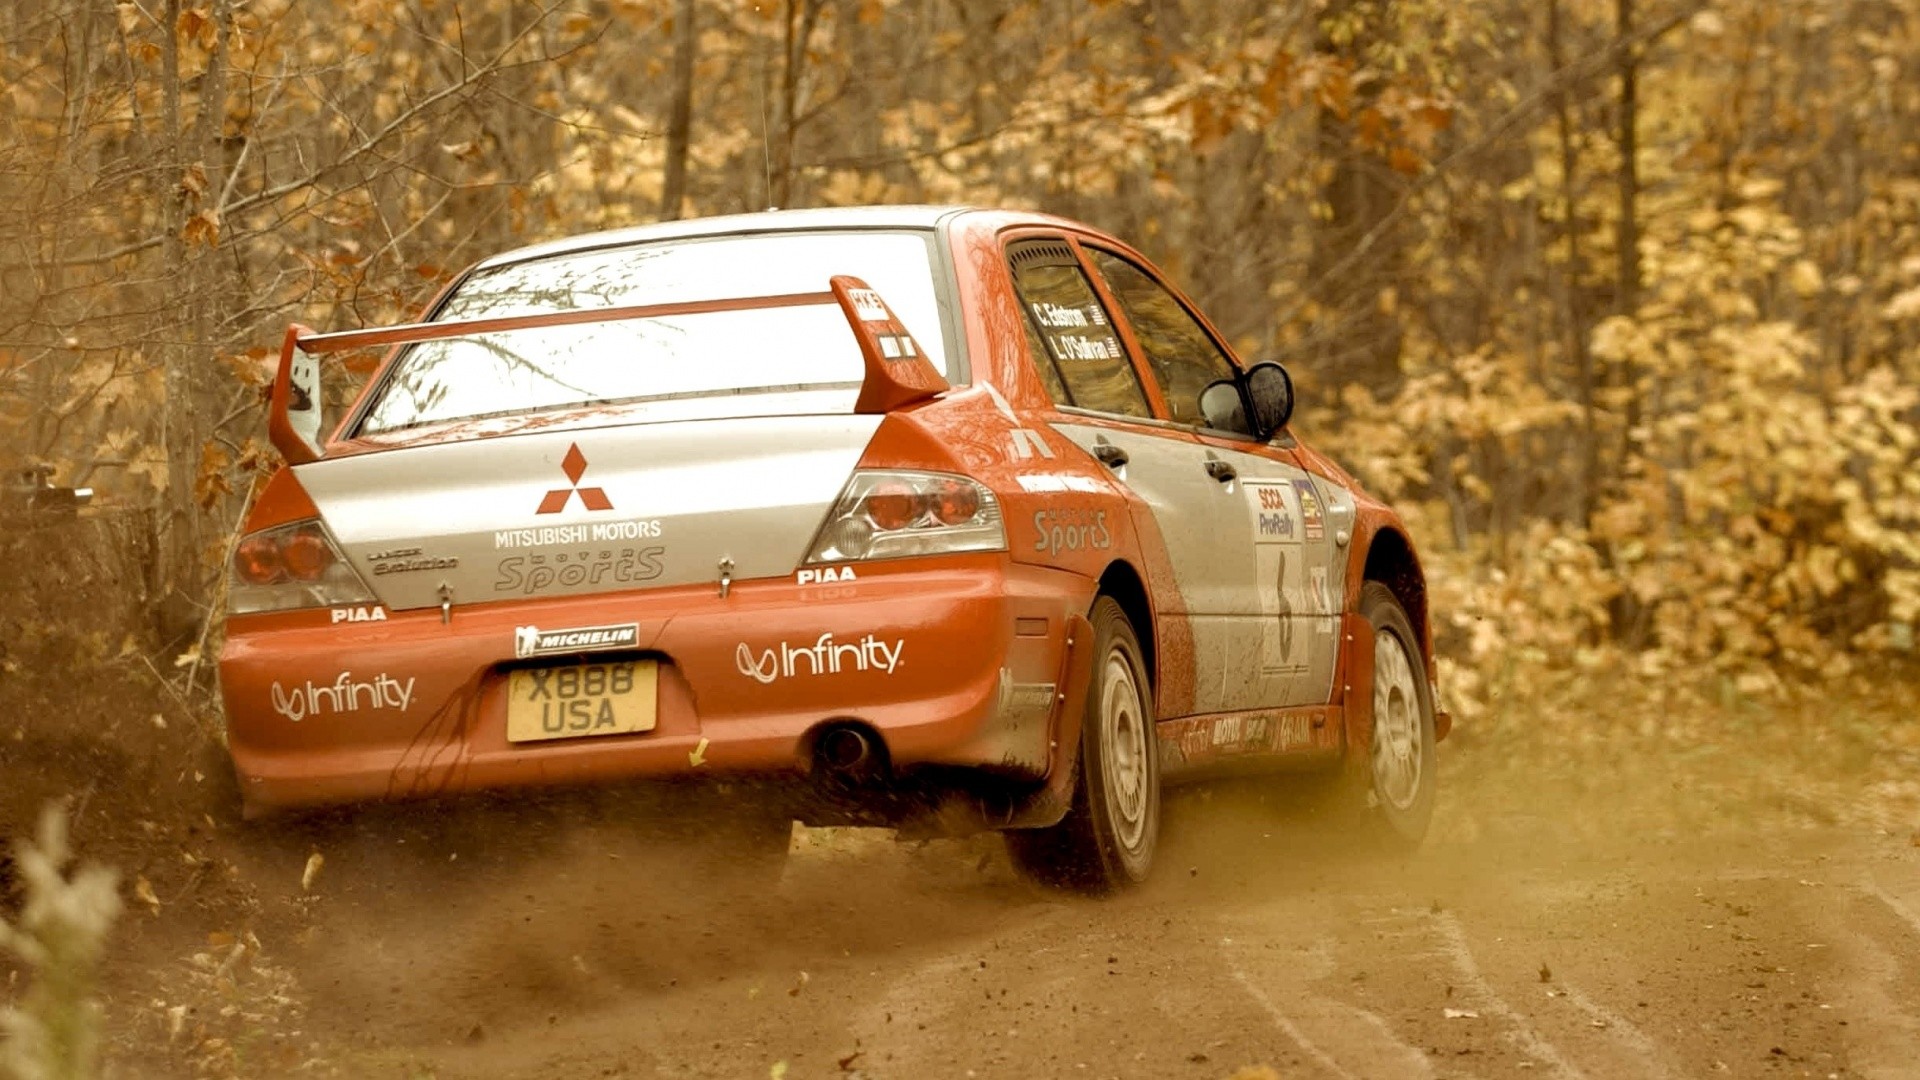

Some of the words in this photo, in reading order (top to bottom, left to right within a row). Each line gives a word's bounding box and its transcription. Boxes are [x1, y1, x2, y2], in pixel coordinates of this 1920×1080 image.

[1032, 303, 1051, 326] C.
[1049, 336, 1067, 359] L.
[1258, 488, 1287, 509] SCCA
[495, 525, 588, 548] MITSUBISHI
[592, 520, 661, 541] MOTORS
[1259, 513, 1294, 540] ProRally
[797, 566, 857, 585] PIAA
[331, 606, 387, 623] PIAA
[1277, 551, 1293, 664] 6
[541, 629, 634, 648] MICHELIN
[528, 664, 634, 701] X888
[543, 698, 616, 733] USA
